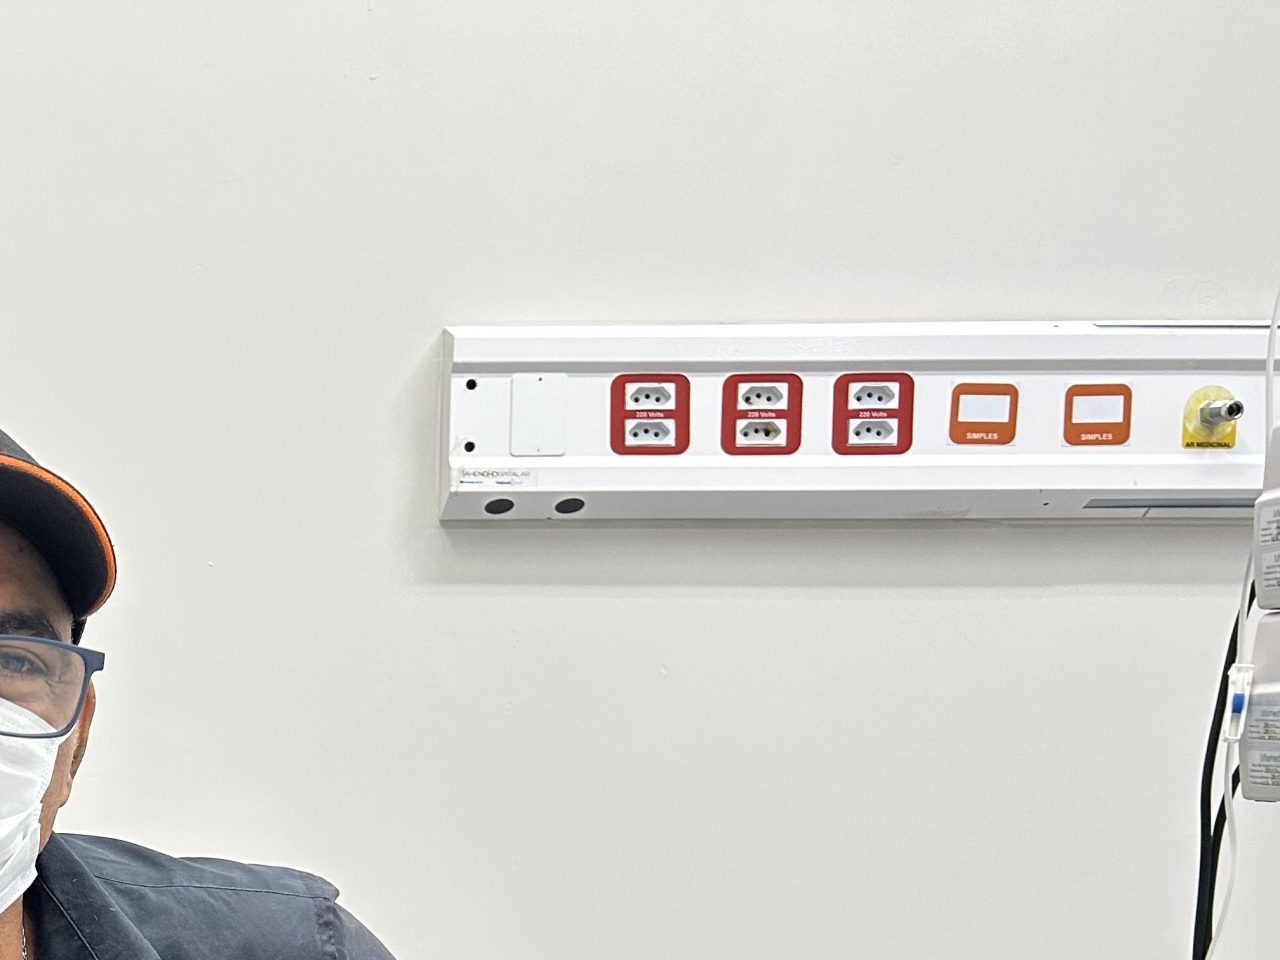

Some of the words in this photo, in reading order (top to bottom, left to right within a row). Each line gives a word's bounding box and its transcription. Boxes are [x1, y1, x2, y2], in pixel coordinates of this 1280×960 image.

[966, 432, 999, 440] SIMPLES
[1080, 433, 1113, 441] SIMPLES
[1196, 441, 1232, 449] MEDICINAL
